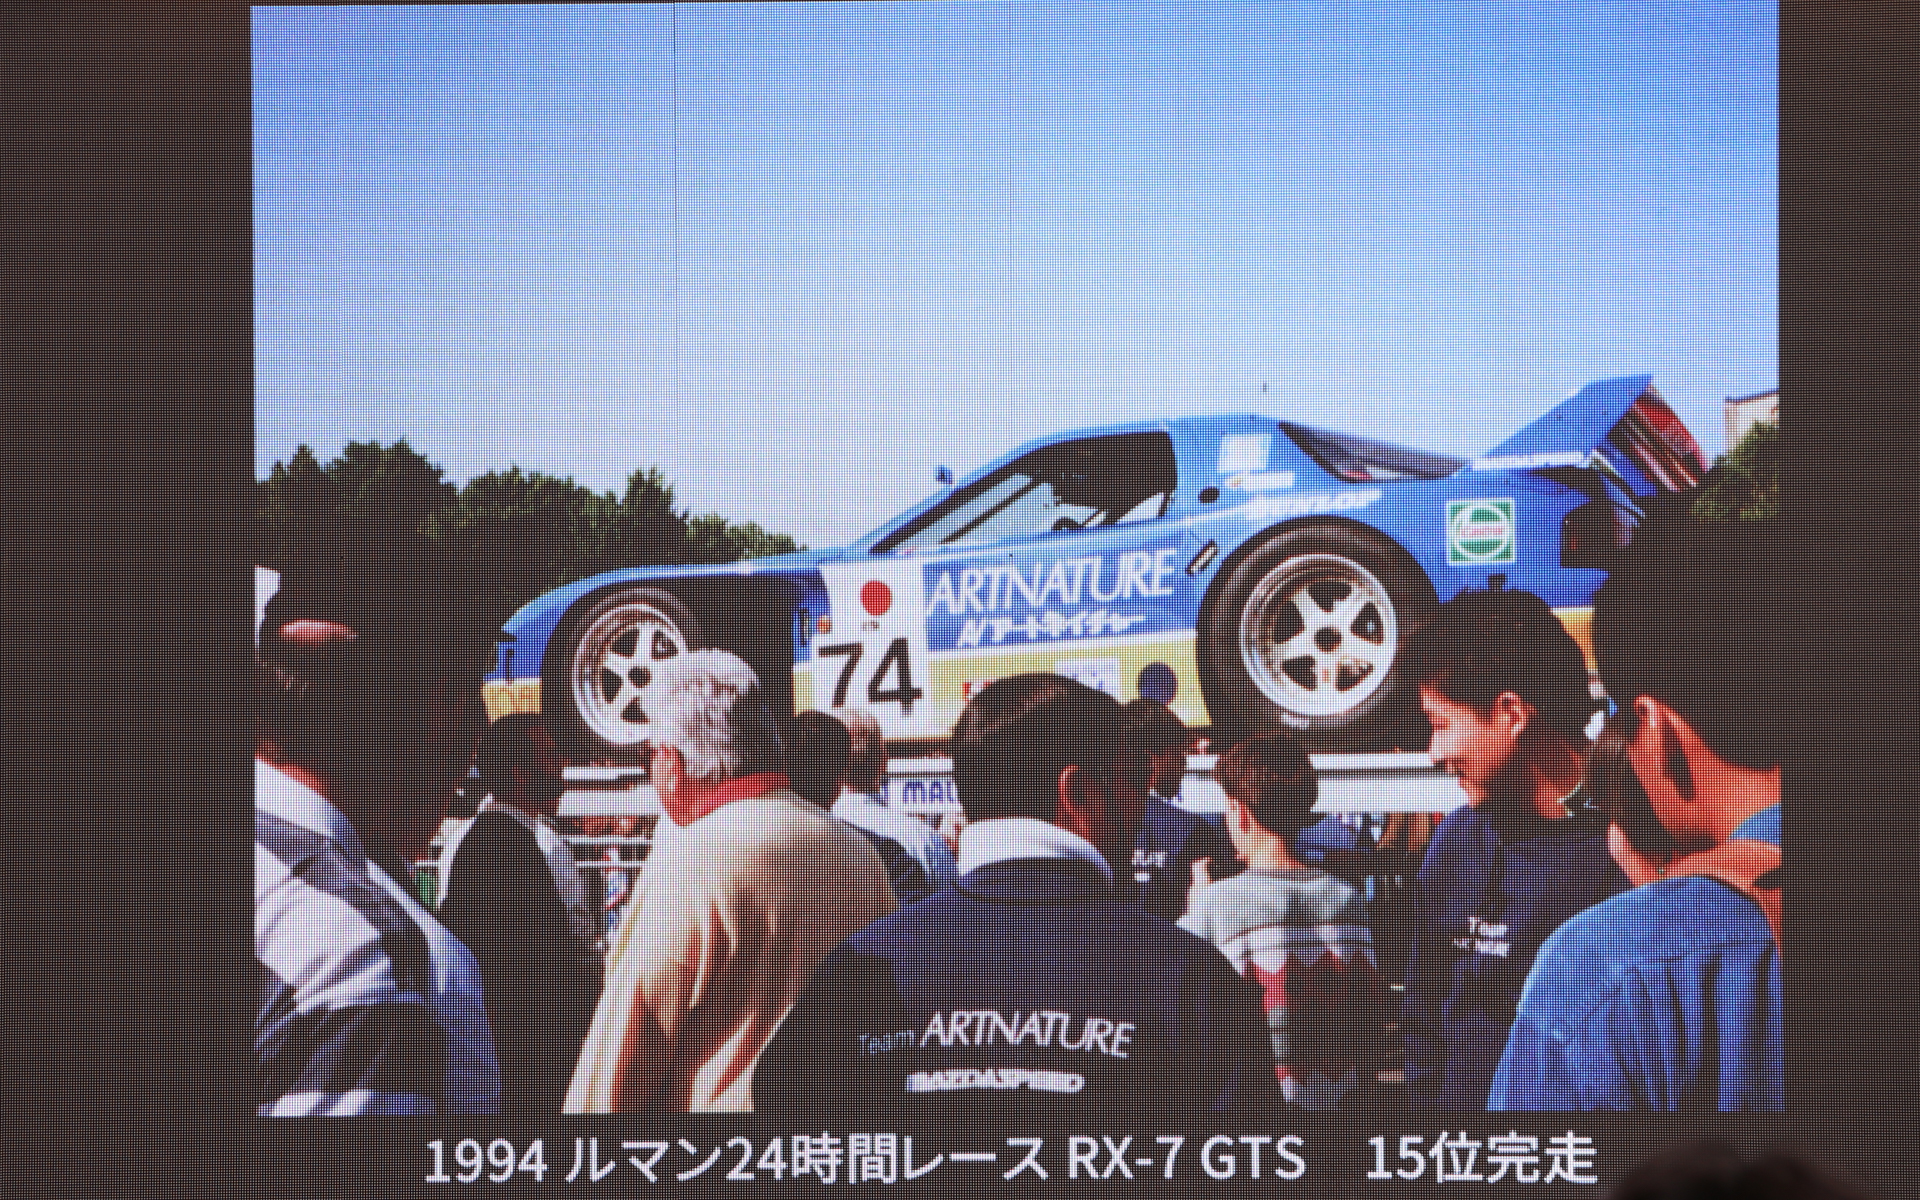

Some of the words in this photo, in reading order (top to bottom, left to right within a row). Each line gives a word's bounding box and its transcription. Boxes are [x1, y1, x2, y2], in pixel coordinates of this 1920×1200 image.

[926, 548, 1177, 617] ARTNATURE
[818, 636, 922, 717] 74
[858, 1030, 915, 1055] Team
[918, 1009, 1136, 1058] ARTNATURE
[425, 1138, 548, 1183] 1994
[565, 1132, 1049, 1184] ルマン24時間レース
[1067, 1135, 1184, 1179] RX-7
[1200, 1135, 1307, 1179] GTS
[1366, 1131, 1599, 1183] 15位完走
